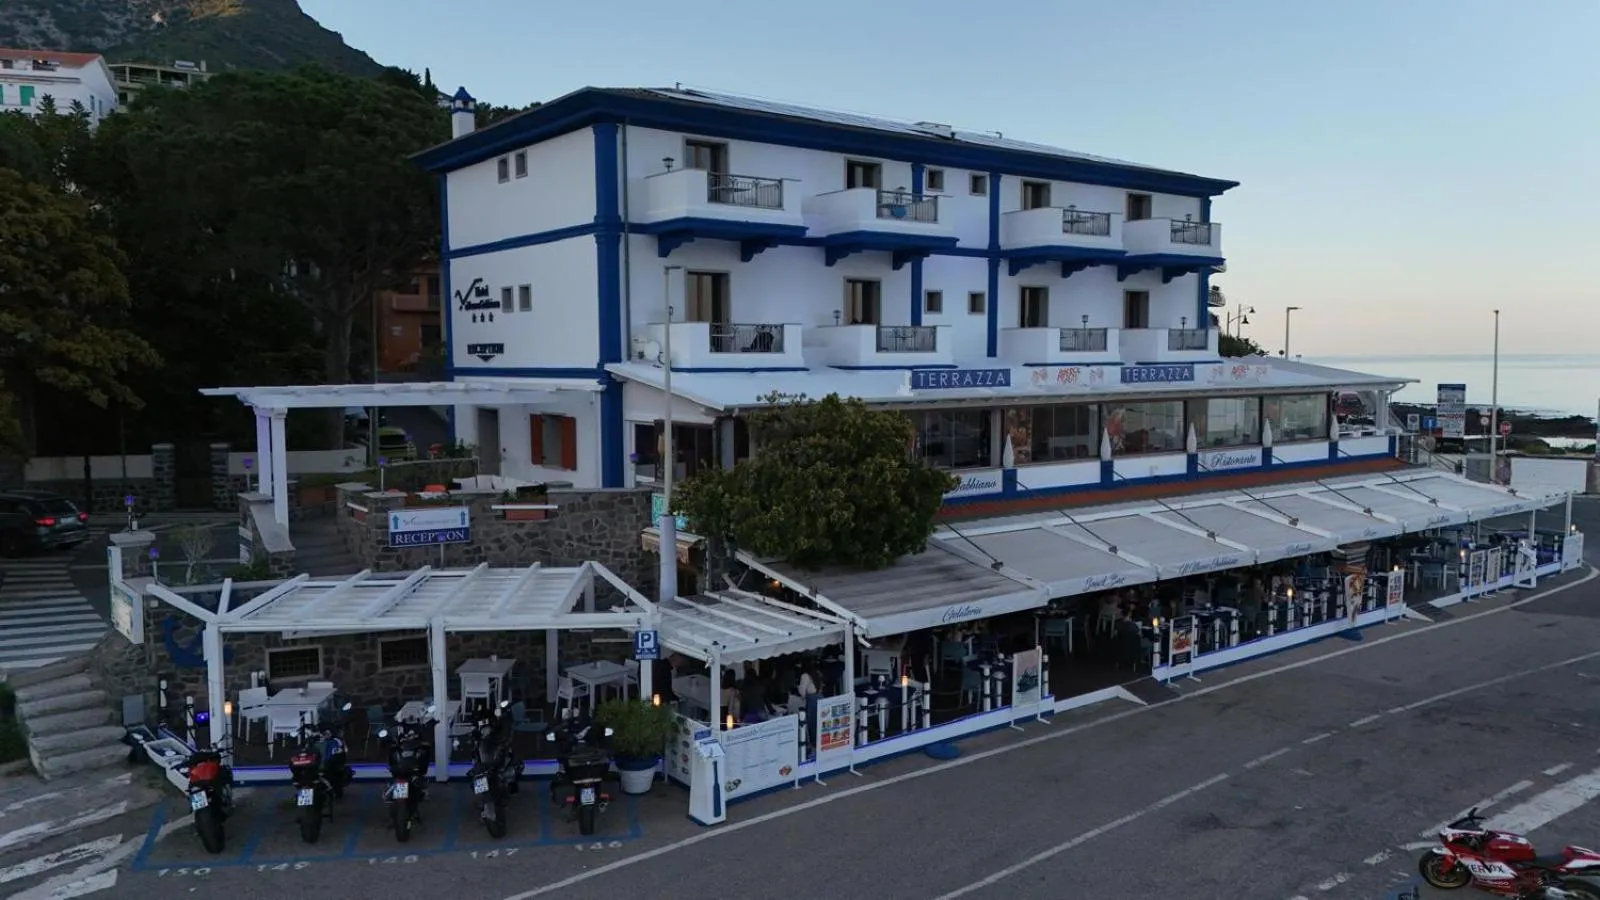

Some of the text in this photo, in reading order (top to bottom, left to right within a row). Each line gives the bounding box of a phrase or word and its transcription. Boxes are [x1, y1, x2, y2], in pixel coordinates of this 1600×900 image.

[917, 371, 1006, 387] TERRAZZA
[1124, 366, 1190, 382] TERRAZZA
[394, 529, 465, 544] RECEPON
[942, 606, 982, 622] Gelateria
[641, 633, 651, 647] P
[158, 867, 211, 877] 150
